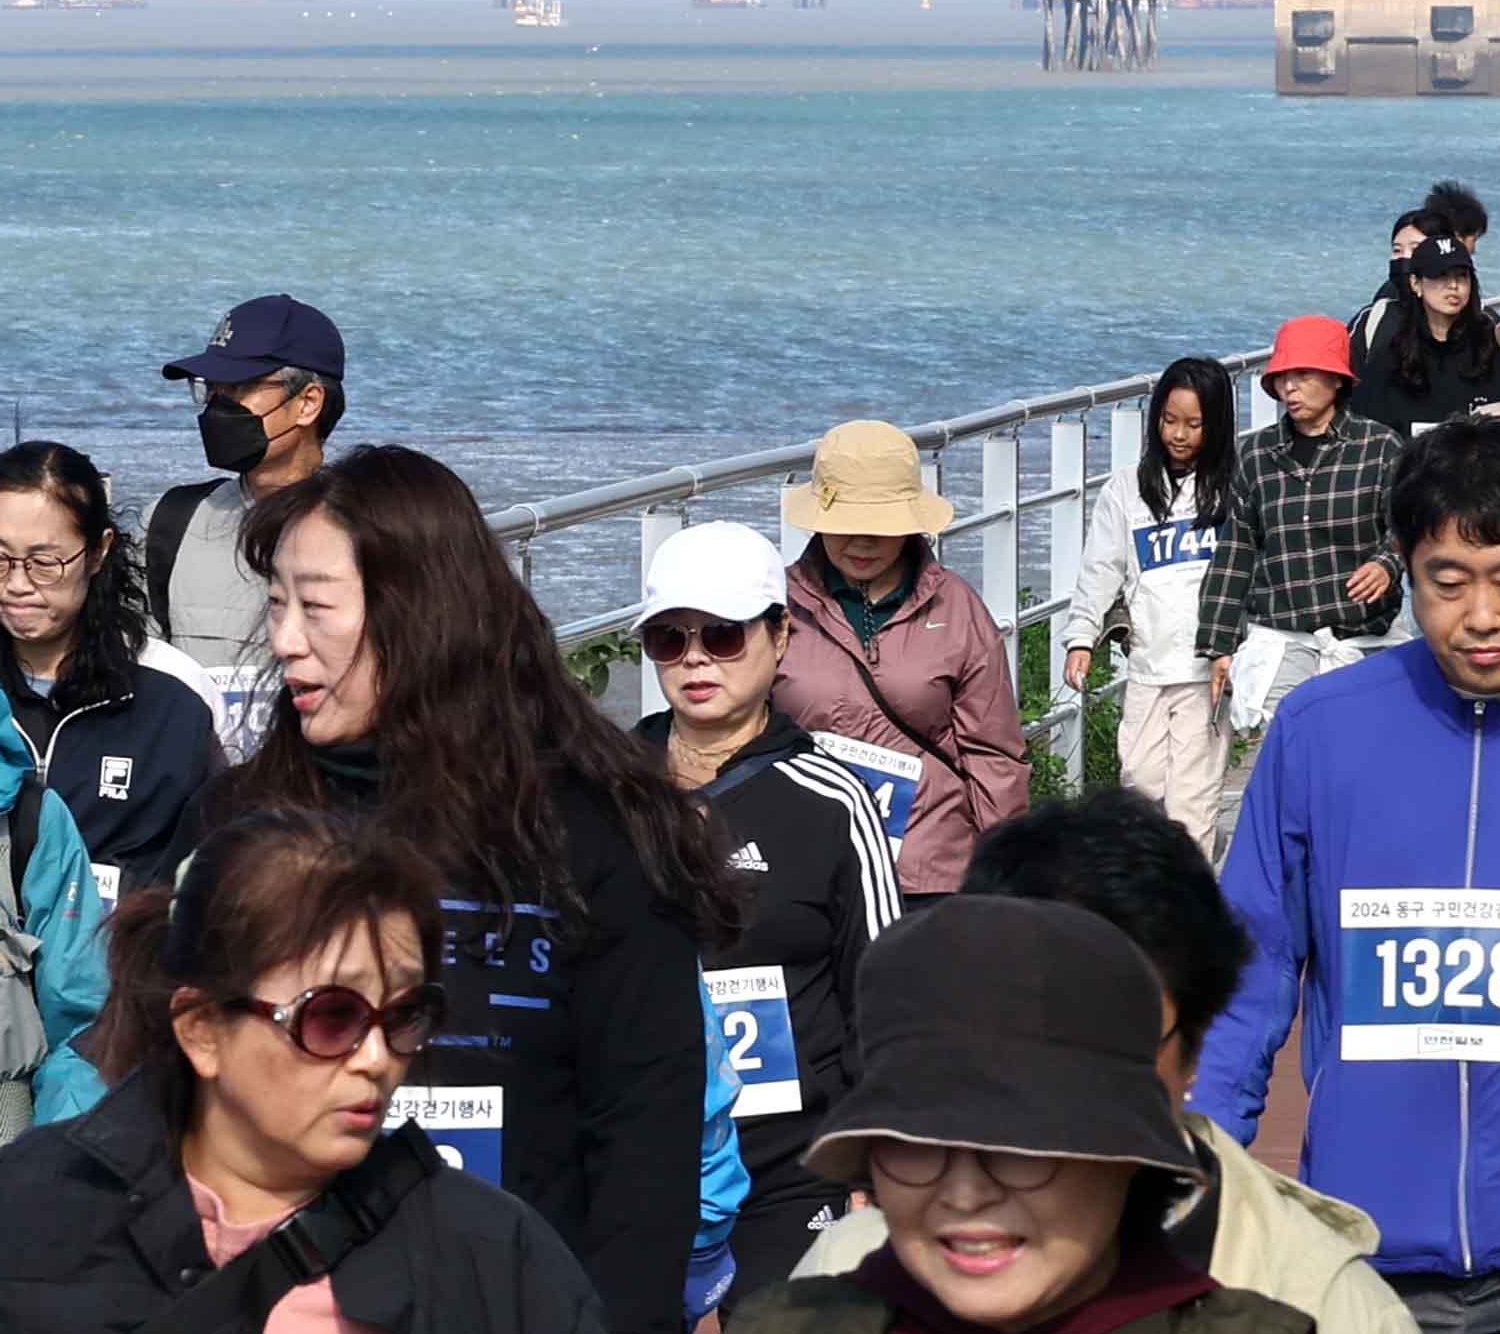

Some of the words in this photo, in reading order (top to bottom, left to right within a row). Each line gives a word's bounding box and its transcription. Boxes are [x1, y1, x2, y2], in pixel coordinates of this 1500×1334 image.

[1147, 526, 1219, 563] 1744
[98, 786, 129, 800] FILA
[1350, 901, 1391, 918] 2024
[1396, 901, 1425, 919] 동구
